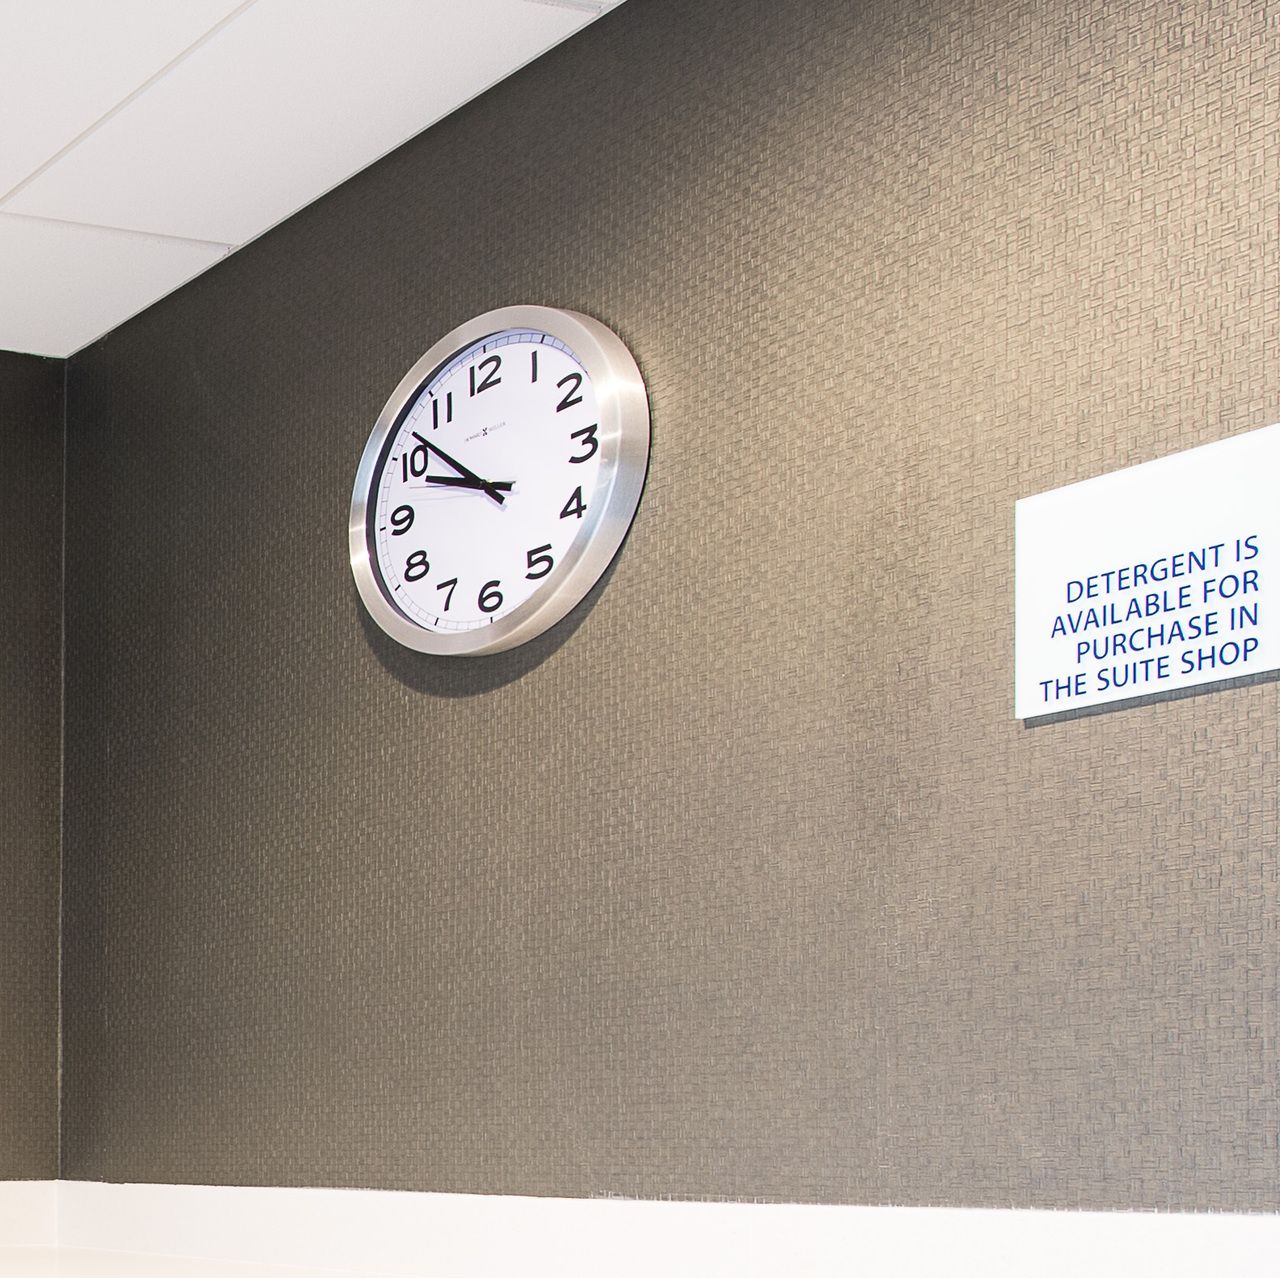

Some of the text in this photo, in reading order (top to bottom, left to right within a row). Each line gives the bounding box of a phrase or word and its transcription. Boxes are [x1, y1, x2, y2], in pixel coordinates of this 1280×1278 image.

[469, 355, 502, 397] 12
[532, 351, 538, 383] 1
[432, 392, 453, 430] 11
[556, 372, 583, 413] 2
[568, 423, 598, 463] 3
[402, 444, 428, 483] 10
[391, 504, 415, 536] 9
[559, 486, 587, 519] 4
[404, 550, 430, 582] 8
[525, 544, 554, 579] 5
[1067, 535, 1259, 604] DETERGENT IS
[437, 578, 458, 612] 7
[478, 581, 503, 613] 6
[1050, 569, 1259, 638] AVAILABLE FOR
[1077, 603, 1259, 664] PURCHASE IN
[1040, 637, 1259, 702] THE SUITE SHOP
